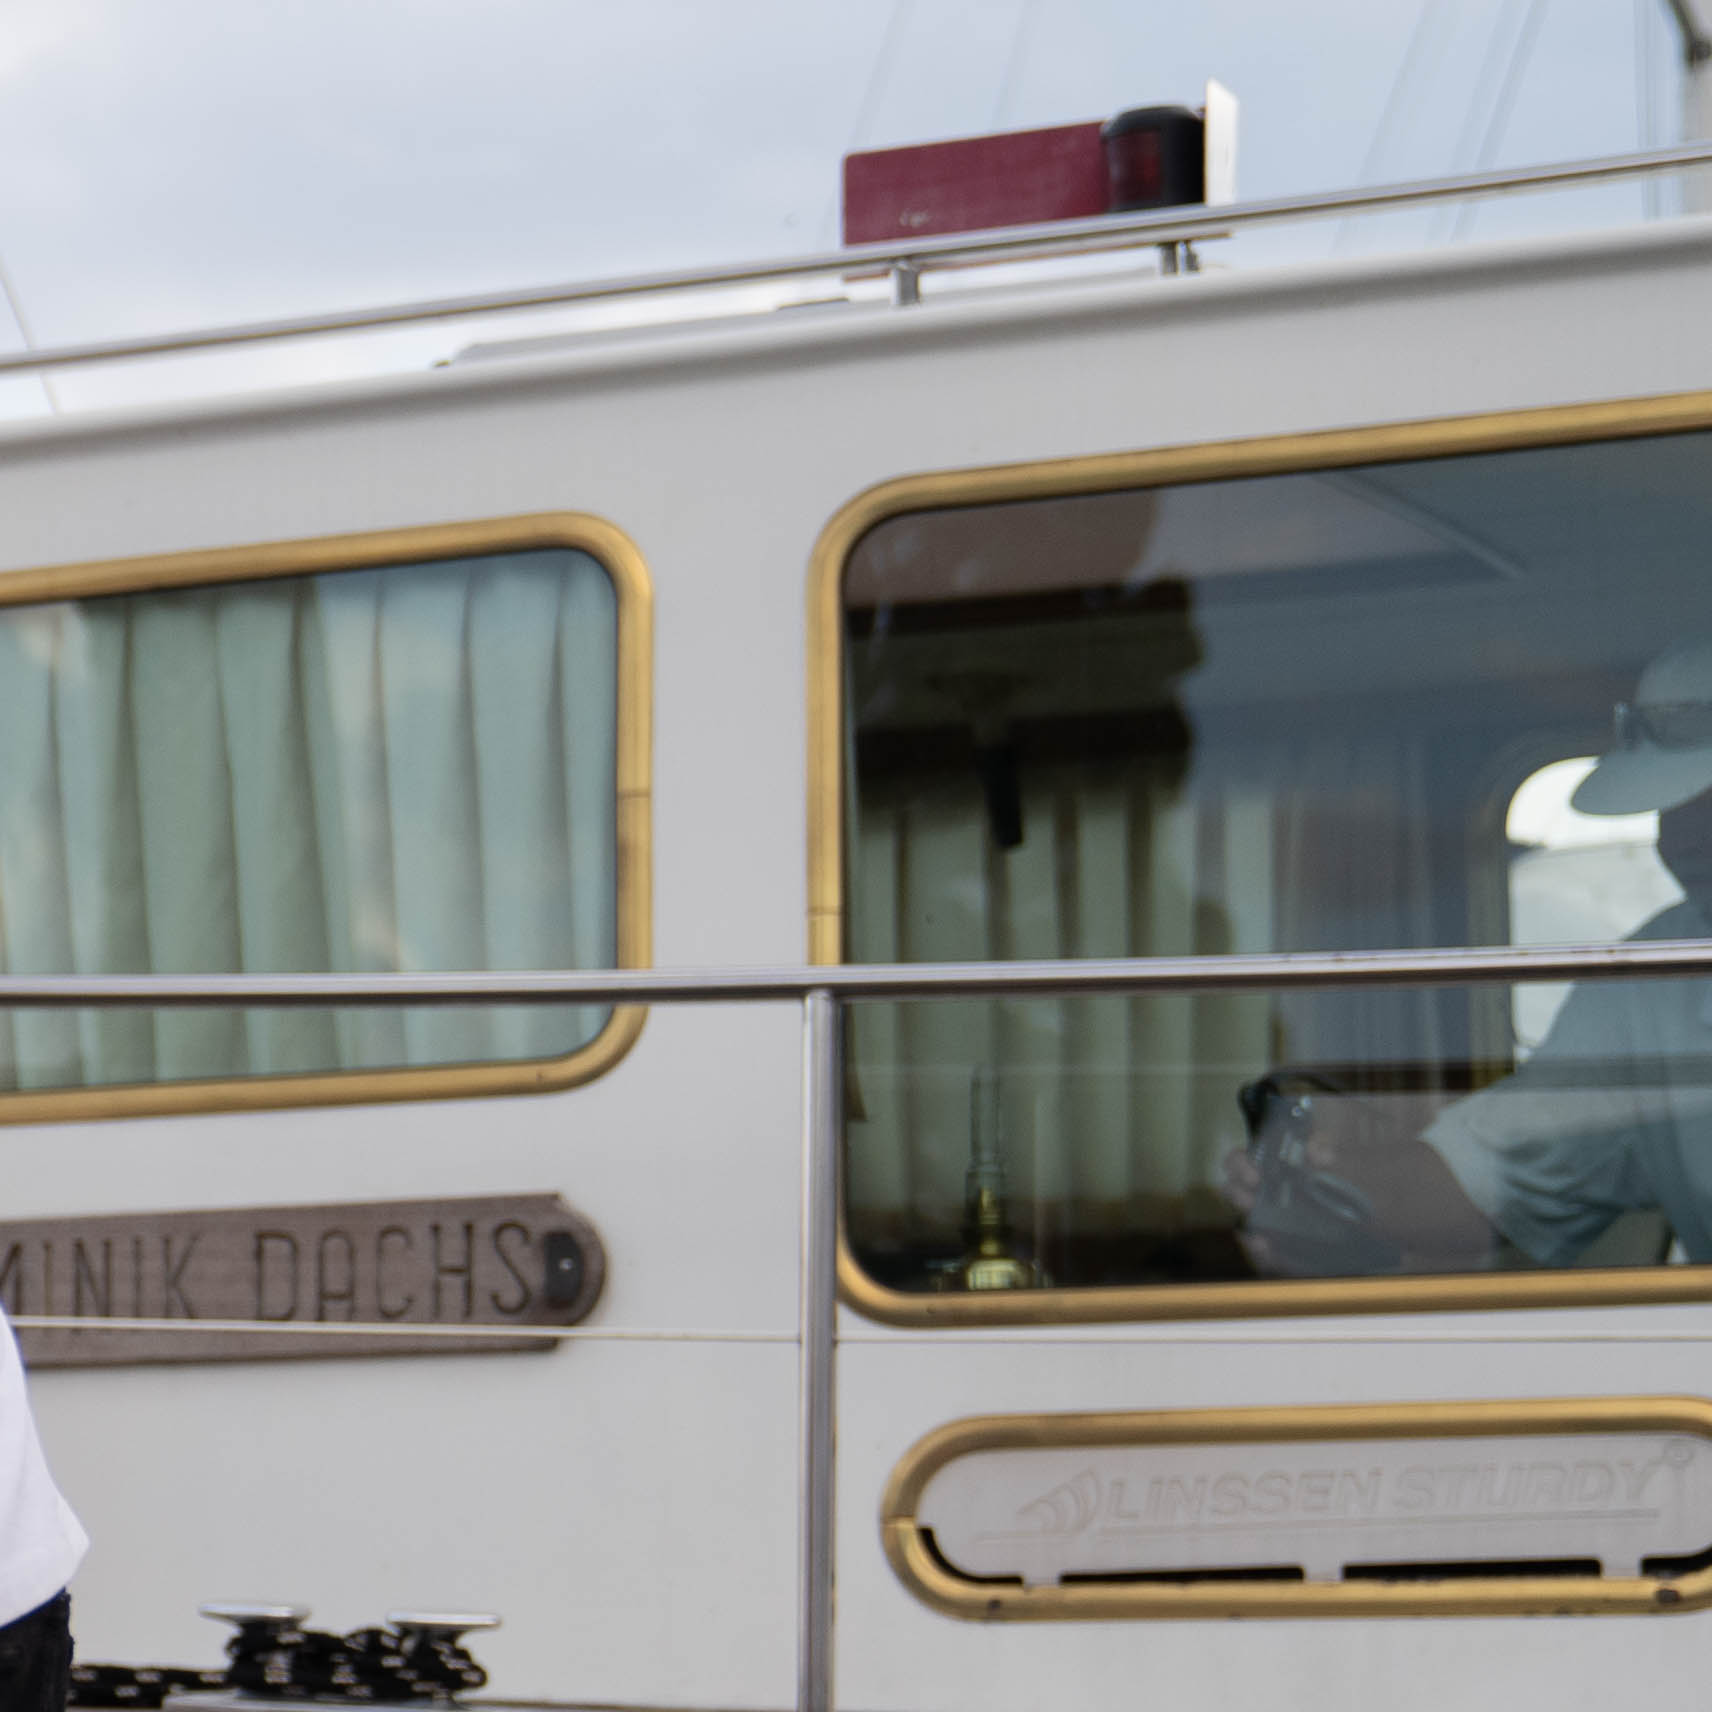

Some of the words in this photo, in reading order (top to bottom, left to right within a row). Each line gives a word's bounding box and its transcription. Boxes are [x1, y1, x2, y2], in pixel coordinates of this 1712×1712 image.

[253, 1219, 533, 1323] DACHS
[1105, 1466, 1384, 1522] LINSSEN
[1391, 1456, 1667, 1513] STURDY
